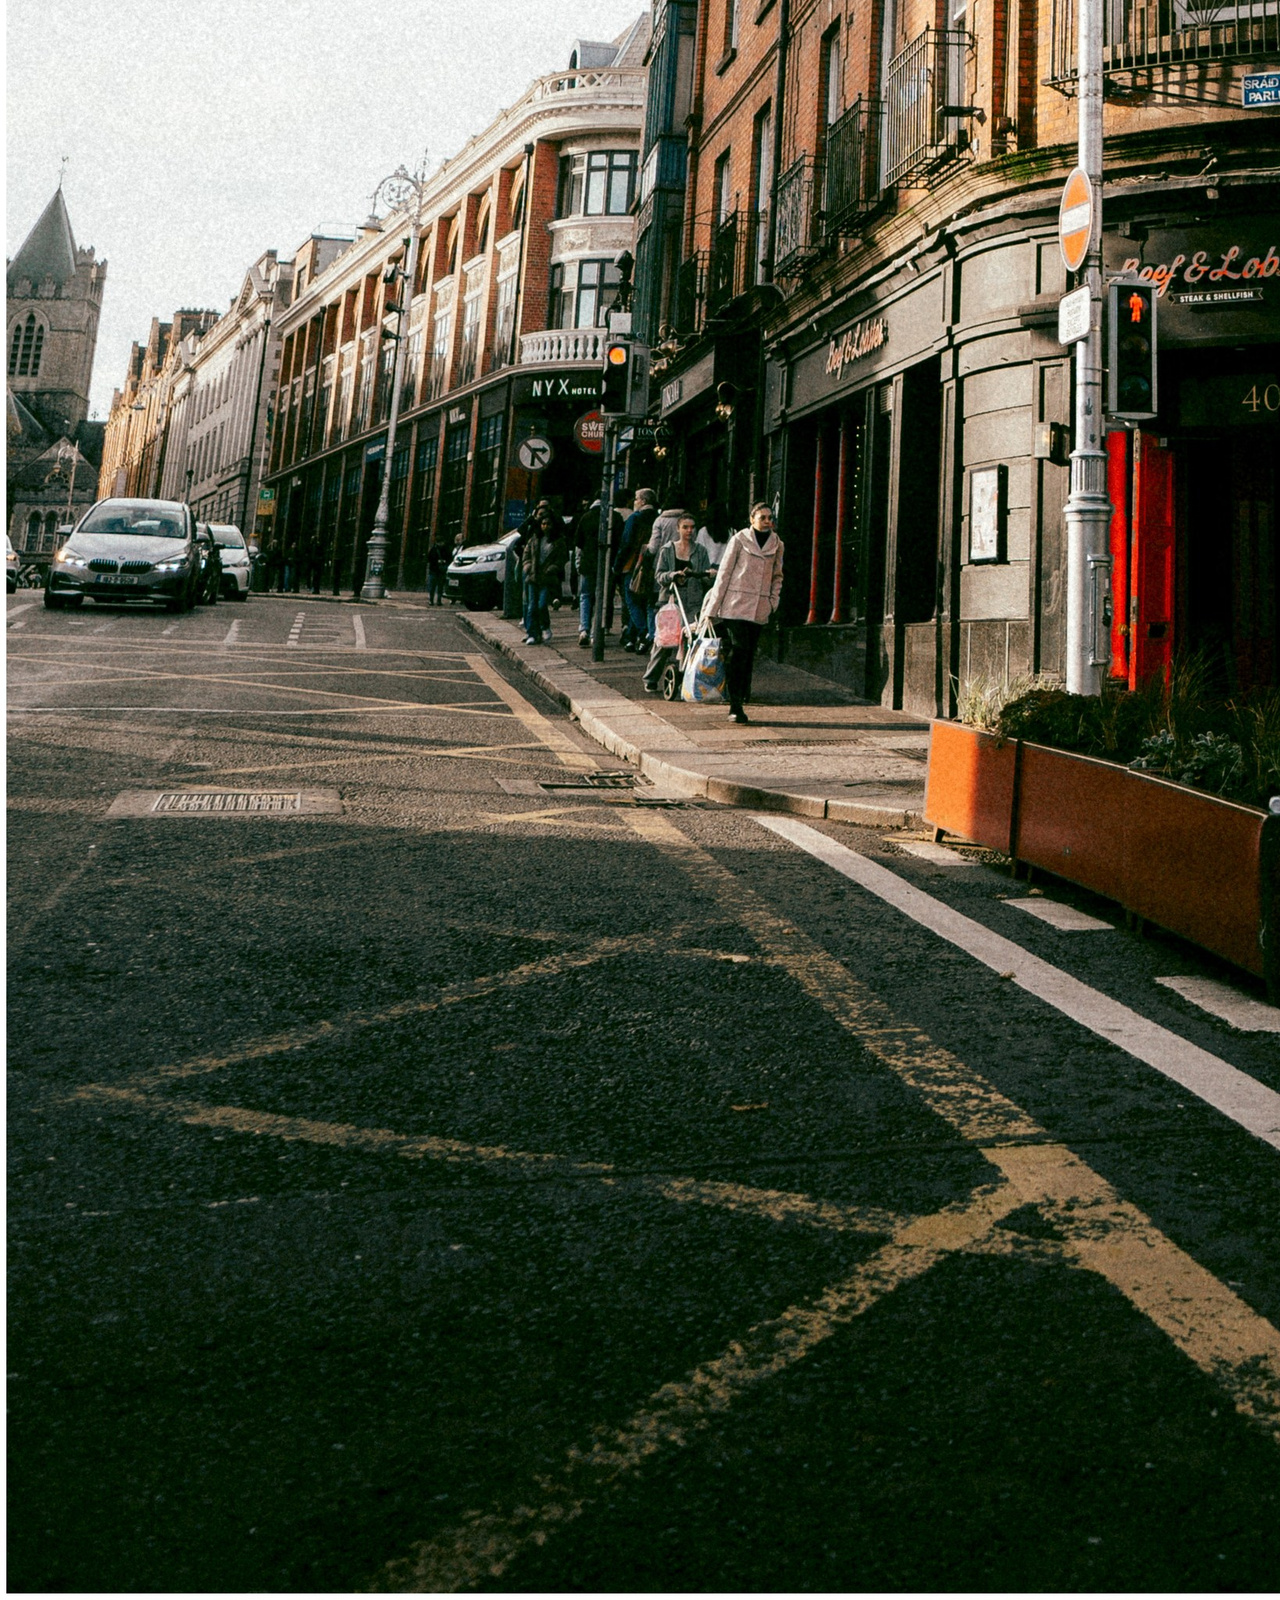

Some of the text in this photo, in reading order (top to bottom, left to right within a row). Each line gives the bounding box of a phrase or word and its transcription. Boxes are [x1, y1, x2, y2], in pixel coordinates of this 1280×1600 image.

[1244, 75, 1278, 89] SRÁID
[1184, 251, 1211, 283] &
[1179, 294, 1204, 303] STEAK
[1213, 290, 1254, 302] SHELLFISH
[532, 379, 597, 397] NYX HOTEL
[581, 421, 605, 431] SWE
[581, 430, 604, 438] CHUR
